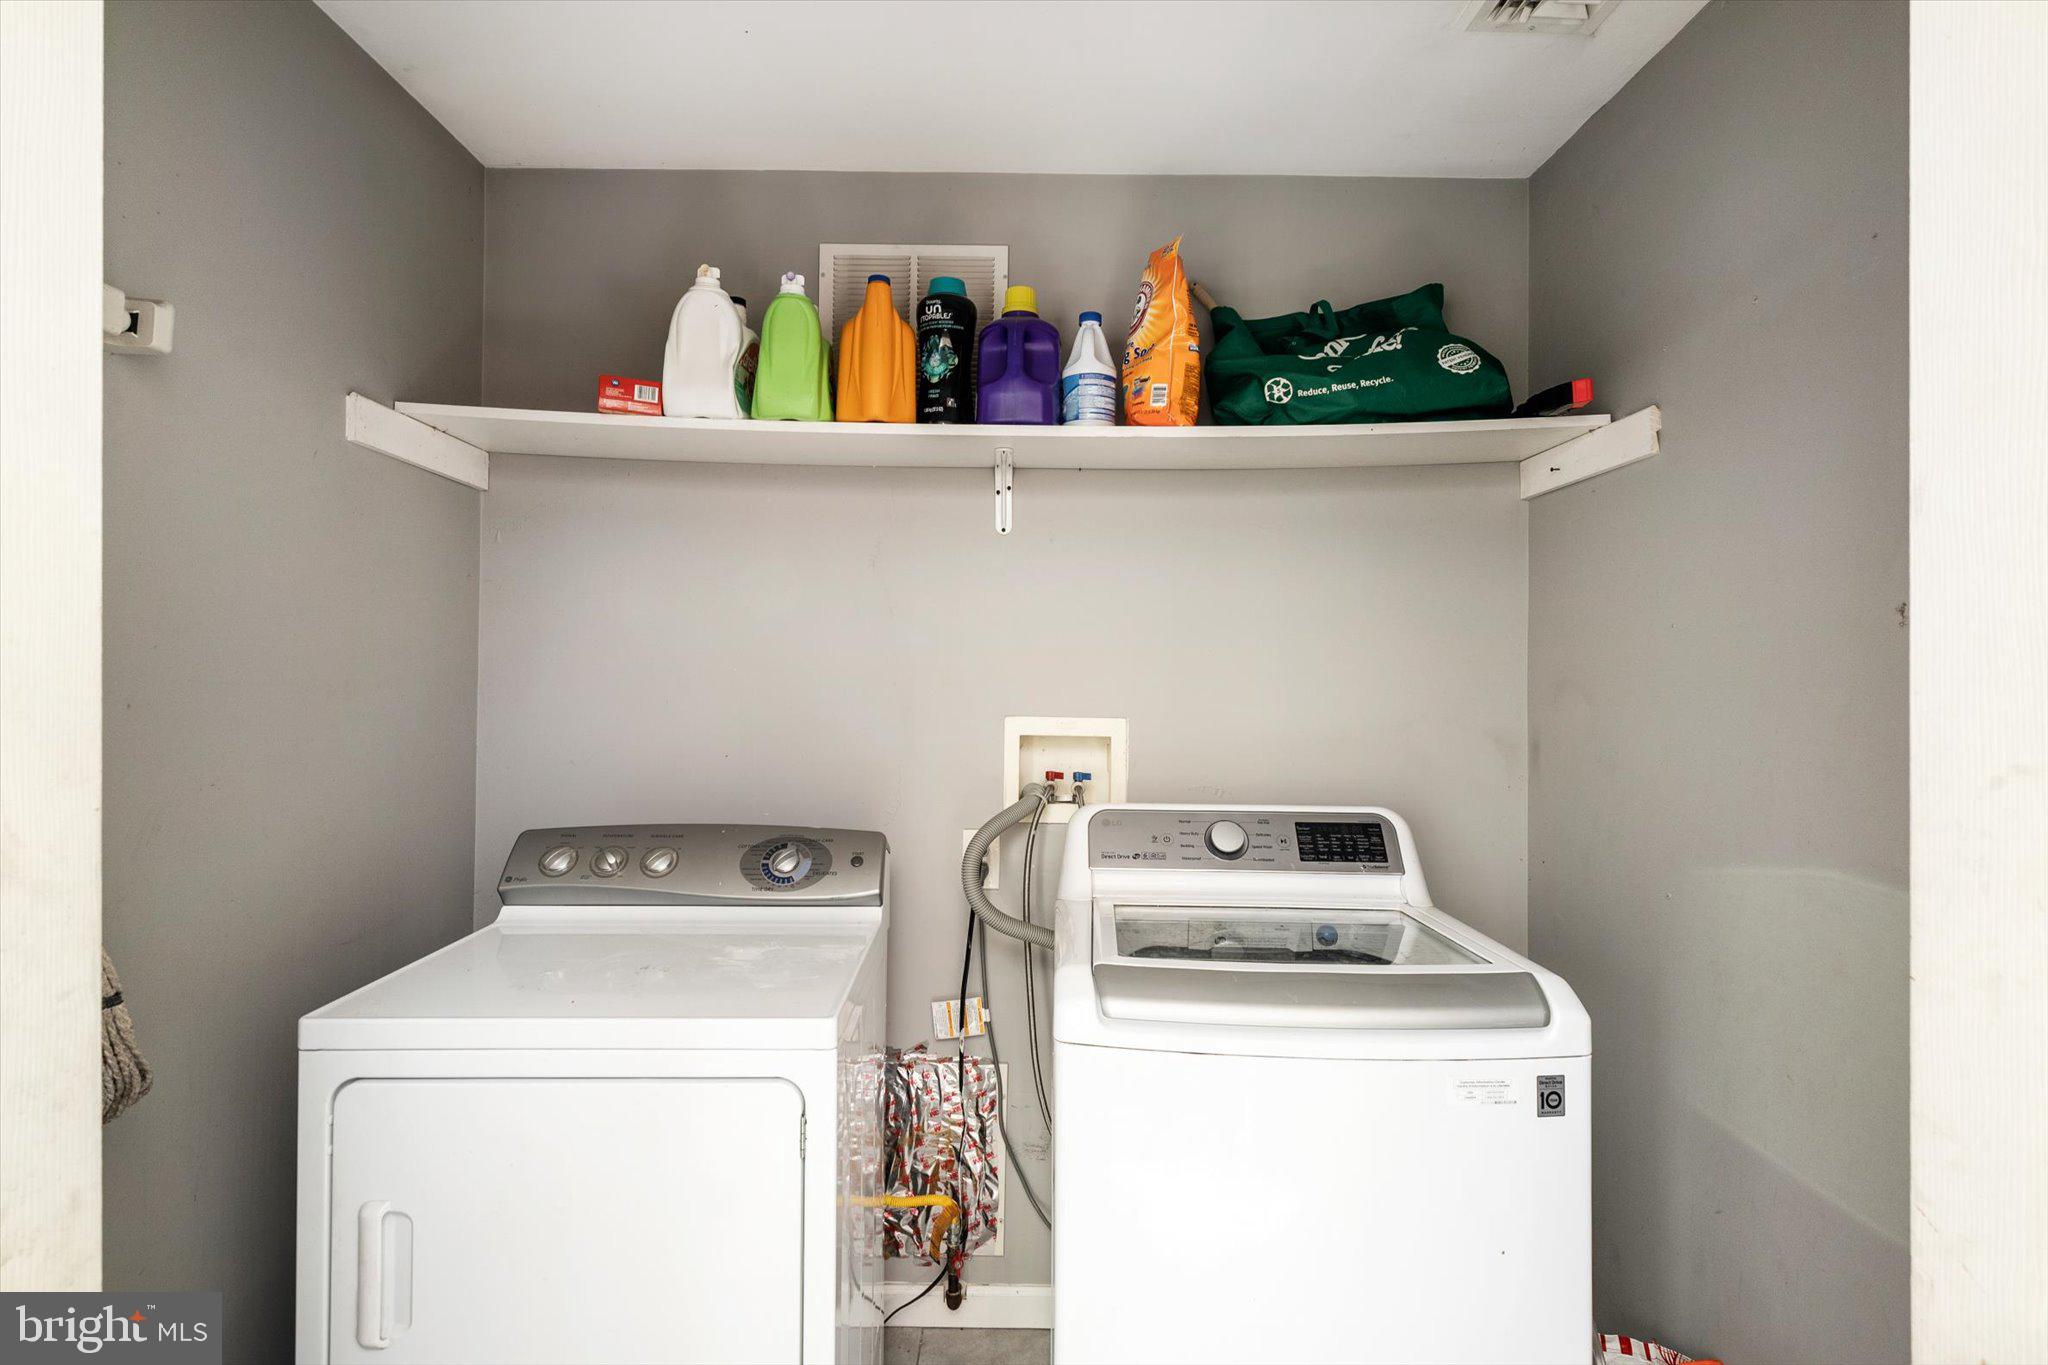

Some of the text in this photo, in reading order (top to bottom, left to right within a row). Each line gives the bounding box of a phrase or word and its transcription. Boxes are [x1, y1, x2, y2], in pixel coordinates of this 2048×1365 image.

[1297, 376, 1394, 397] Reduce, Reuse, Recycle.
[1540, 1090, 1563, 1110] 10
